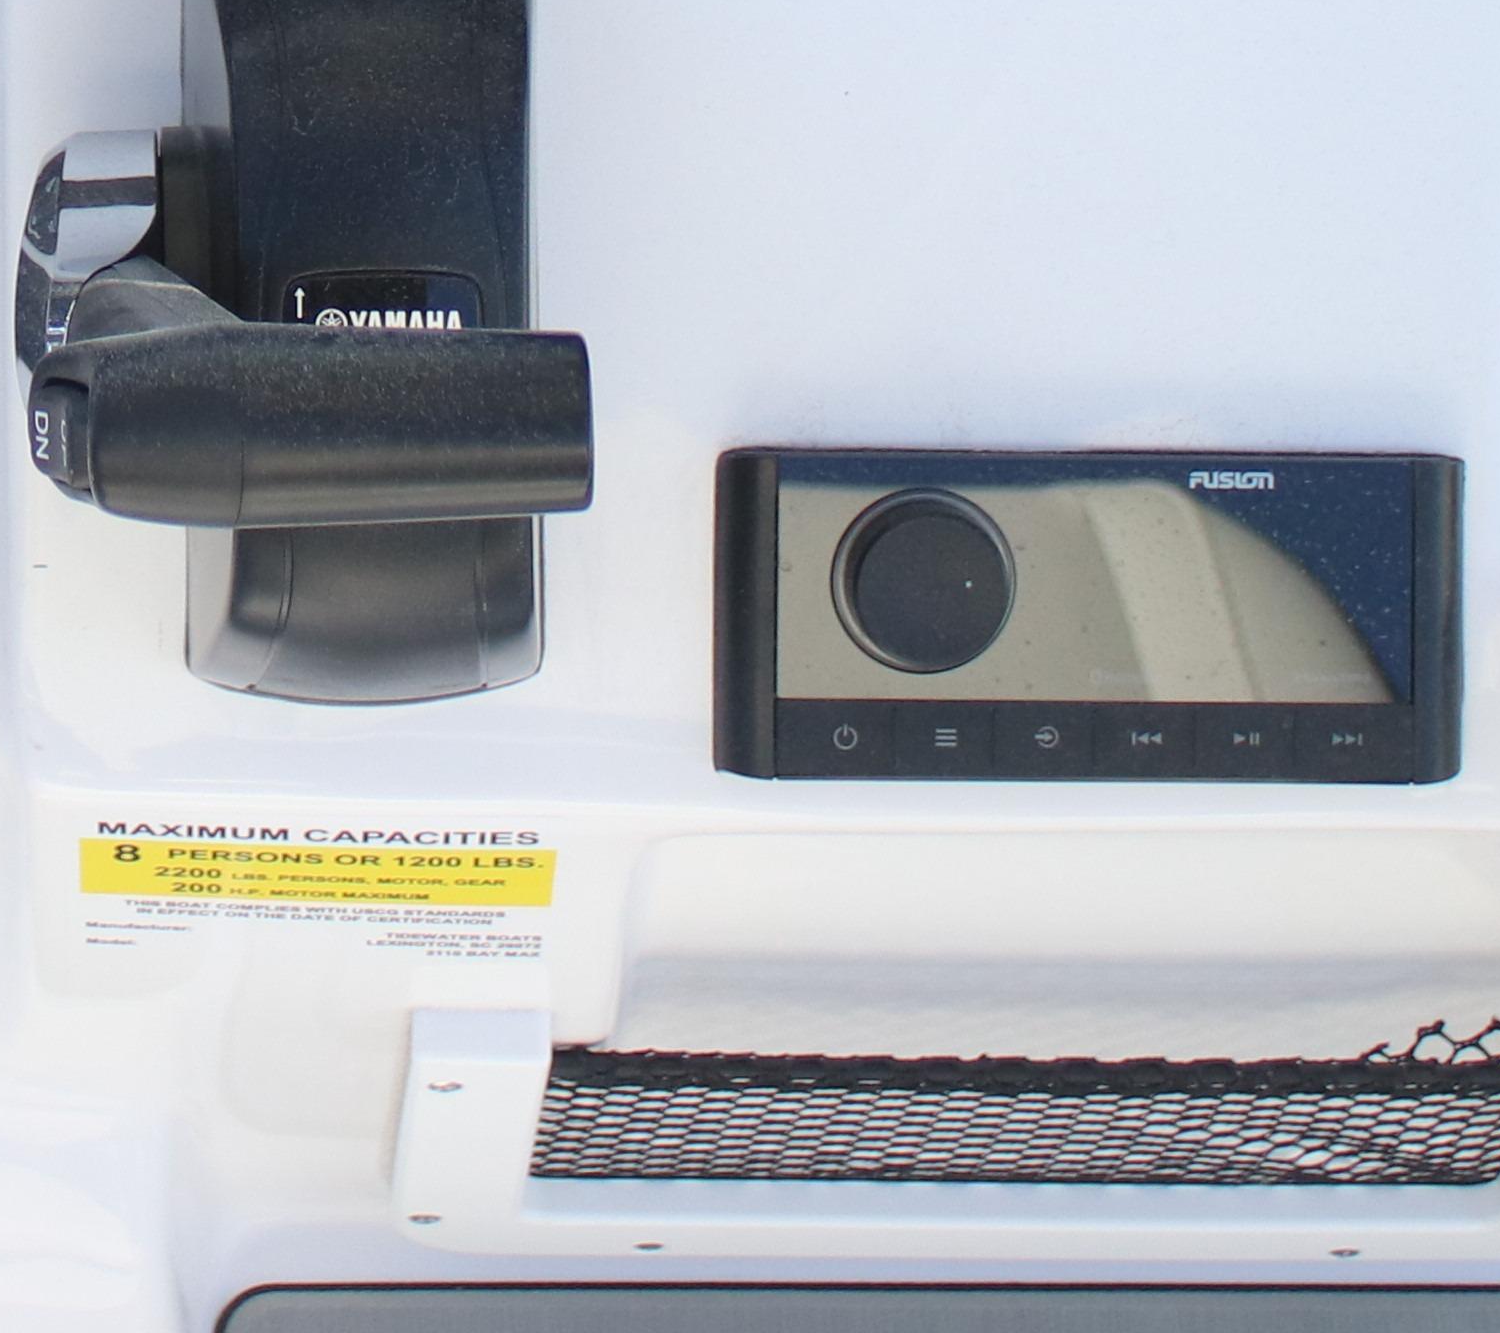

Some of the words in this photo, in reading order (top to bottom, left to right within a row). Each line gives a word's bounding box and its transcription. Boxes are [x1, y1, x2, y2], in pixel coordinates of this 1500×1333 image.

[350, 310, 463, 329] YAMAHA
[34, 409, 50, 460] DN
[1189, 471, 1274, 490] FUSION
[97, 821, 290, 841] MAXIMUM
[303, 828, 540, 846] CAPACITIES
[113, 844, 141, 863] 8
[167, 848, 324, 865] PERSONS
[335, 854, 381, 867] OR
[393, 855, 462, 868] 1200
[473, 856, 544, 869] LBS.
[154, 866, 222, 879] 2200
[231, 873, 272, 881] LBS.
[277, 874, 371, 885] PERSONS,
[376, 877, 449, 887] MOTOR,
[454, 879, 506, 887] GEAR
[170, 882, 223, 893] 200
[275, 889, 336, 898] MOTOR
[342, 891, 430, 900] MAXIMUM
[155, 908, 219, 917] EFFECT
[254, 911, 286, 920] THE
[291, 913, 336, 921] DATE
[340, 914, 362, 922] OF
[367, 915, 493, 926] CERTIFICATION
[165, 900, 211, 909] BOAT
[216, 902, 300, 913] COMPLIES
[305, 905, 348, 915] WITH
[404, 909, 506, 918] STANDARDS
